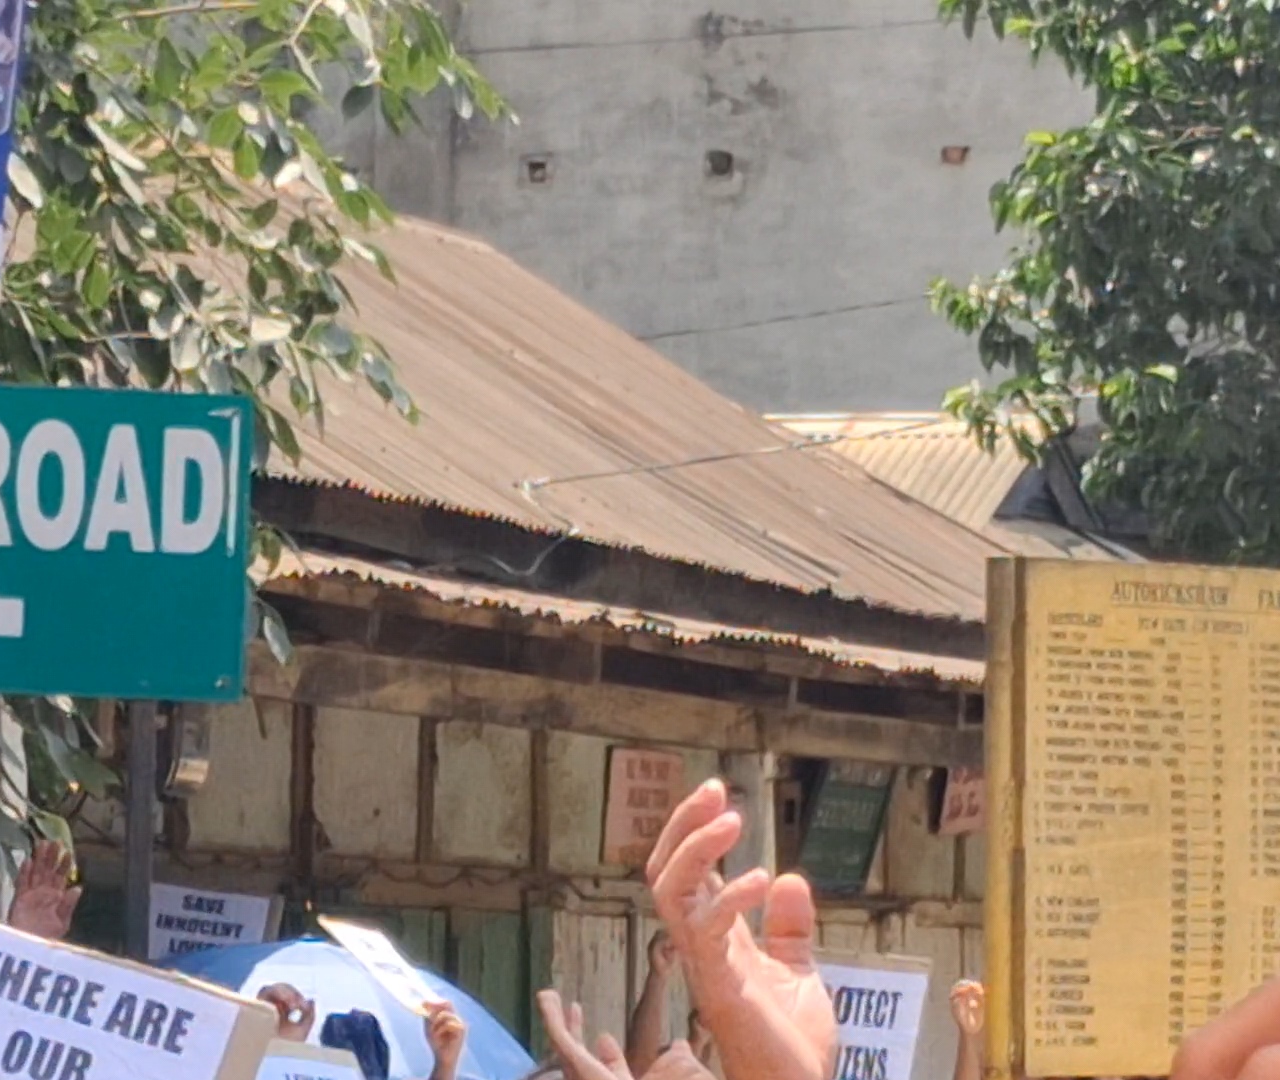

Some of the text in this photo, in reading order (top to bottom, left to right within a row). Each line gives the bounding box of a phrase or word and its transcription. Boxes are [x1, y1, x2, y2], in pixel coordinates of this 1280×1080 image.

[181, 894, 225, 915] SAVE
[156, 912, 244, 938] INNOCENT
[102, 989, 196, 1056] ARE
[826, 984, 903, 1030] OTECT
